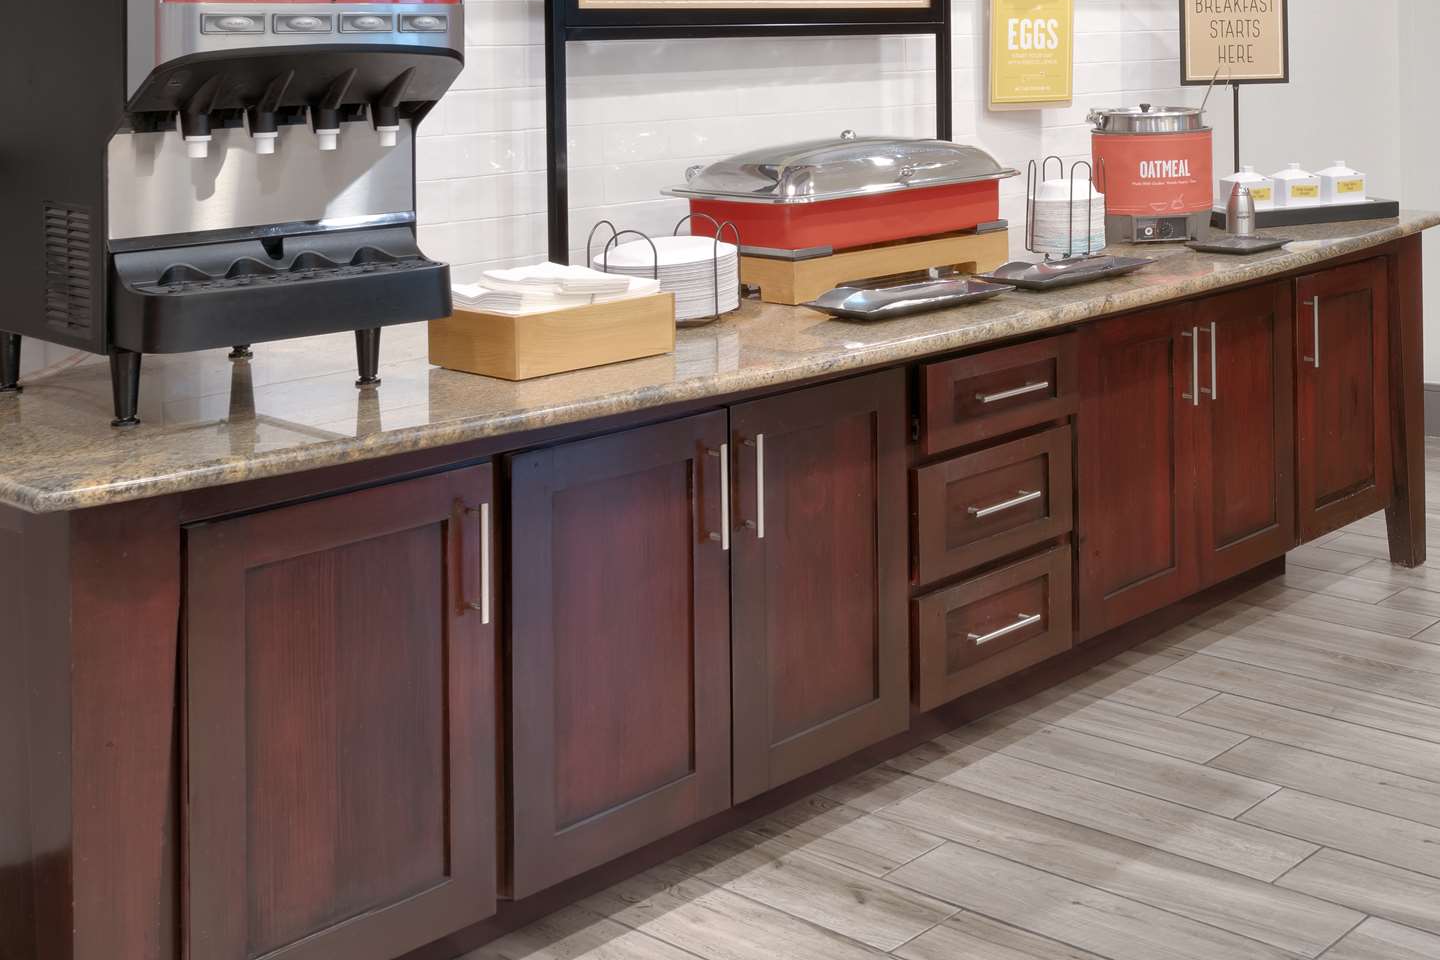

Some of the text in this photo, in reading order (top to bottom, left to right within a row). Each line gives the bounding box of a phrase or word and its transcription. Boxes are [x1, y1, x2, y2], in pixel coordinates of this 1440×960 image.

[1007, 17, 1059, 51] EGGS
[1209, 19, 1261, 38] STARTS
[1218, 44, 1254, 64] HERE
[1139, 159, 1191, 178] OATMEAL
